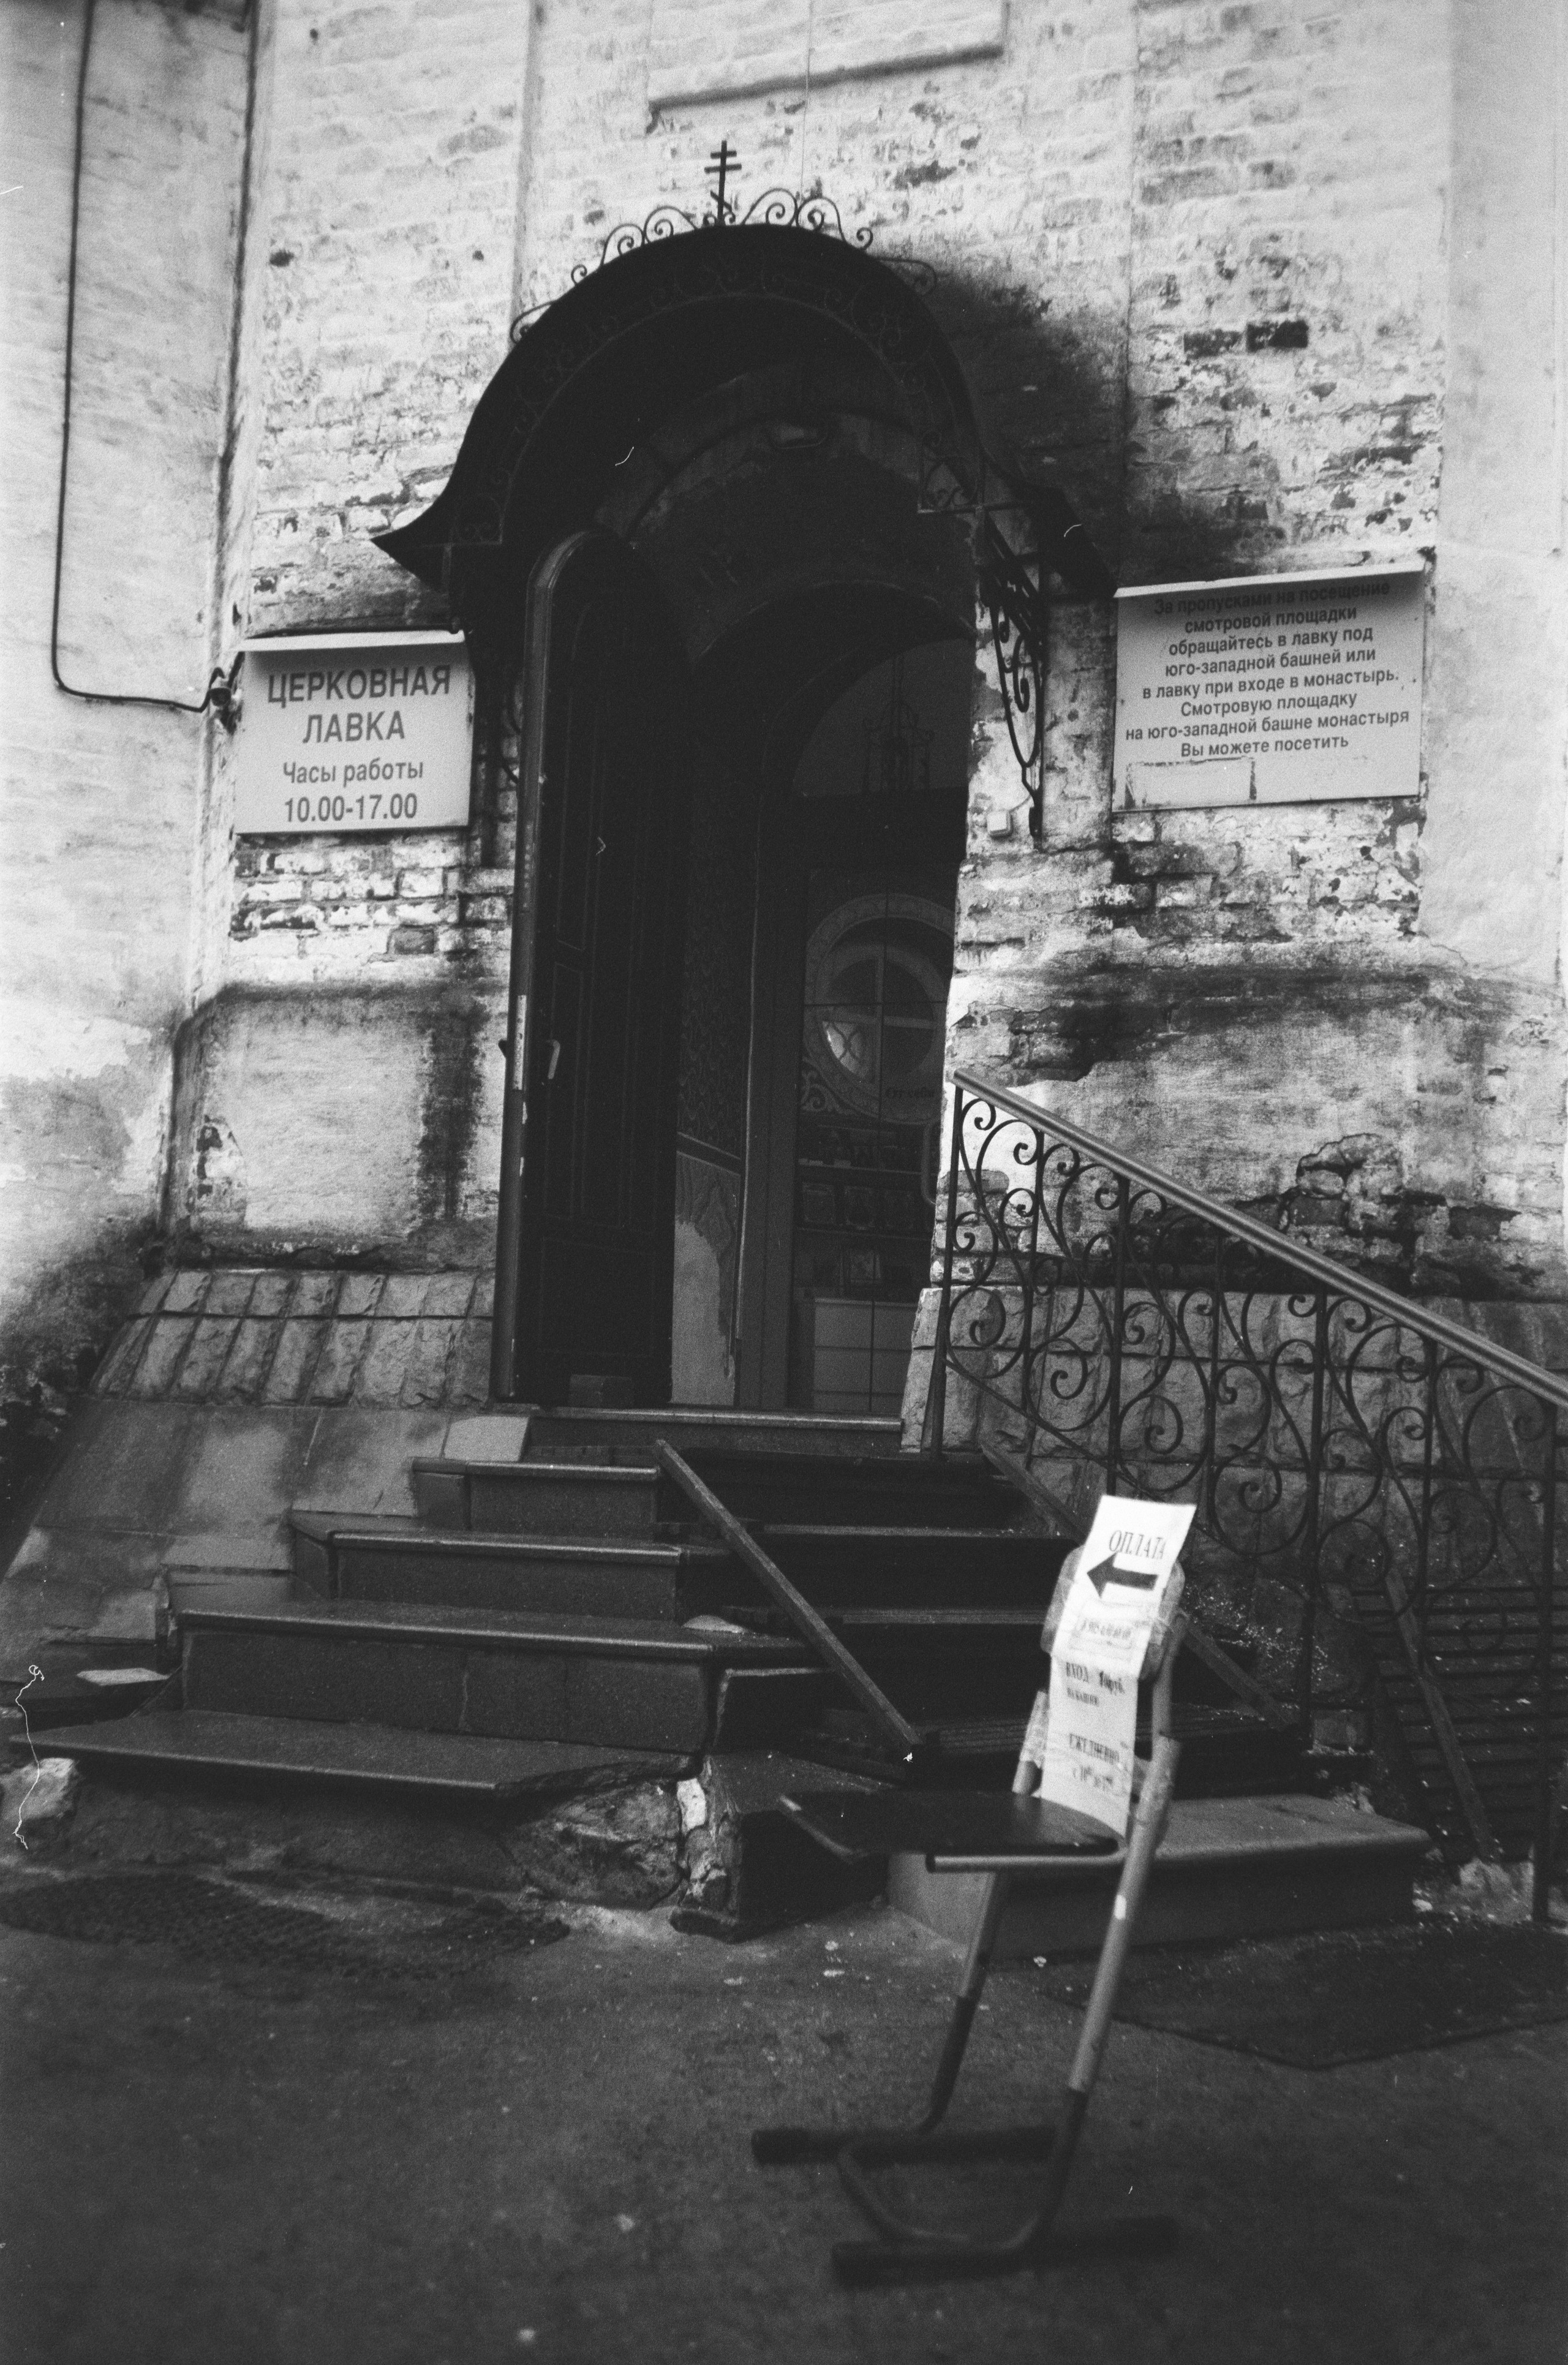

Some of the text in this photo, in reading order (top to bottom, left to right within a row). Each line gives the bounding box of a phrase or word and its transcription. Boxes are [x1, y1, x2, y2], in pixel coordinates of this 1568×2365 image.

[1155, 581, 1390, 618] За пропусками на посещение
[1185, 606, 1357, 635] смотровой площадки
[1169, 626, 1373, 656] обращайтесь в лавку под
[1166, 645, 1375, 676] юго-западной башней или
[268, 665, 450, 709] ЦЕРКОВНАЯ
[1143, 687, 1151, 698] в
[1156, 682, 1200, 701] лавку
[1205, 679, 1233, 696] при
[1238, 677, 1284, 693] входе
[1290, 677, 1298, 688] в
[1181, 692, 1357, 720] Смотровую площадку
[302, 711, 405, 744] ЛАВКА
[1126, 710, 1409, 740] на юго-западной башне монастыря
[1181, 736, 1348, 757] Вы можете посетить
[283, 757, 423, 787] Часы работы
[284, 793, 417, 822] 10.00-17.00
[1108, 1530, 1167, 1560] ОПЛАТА
